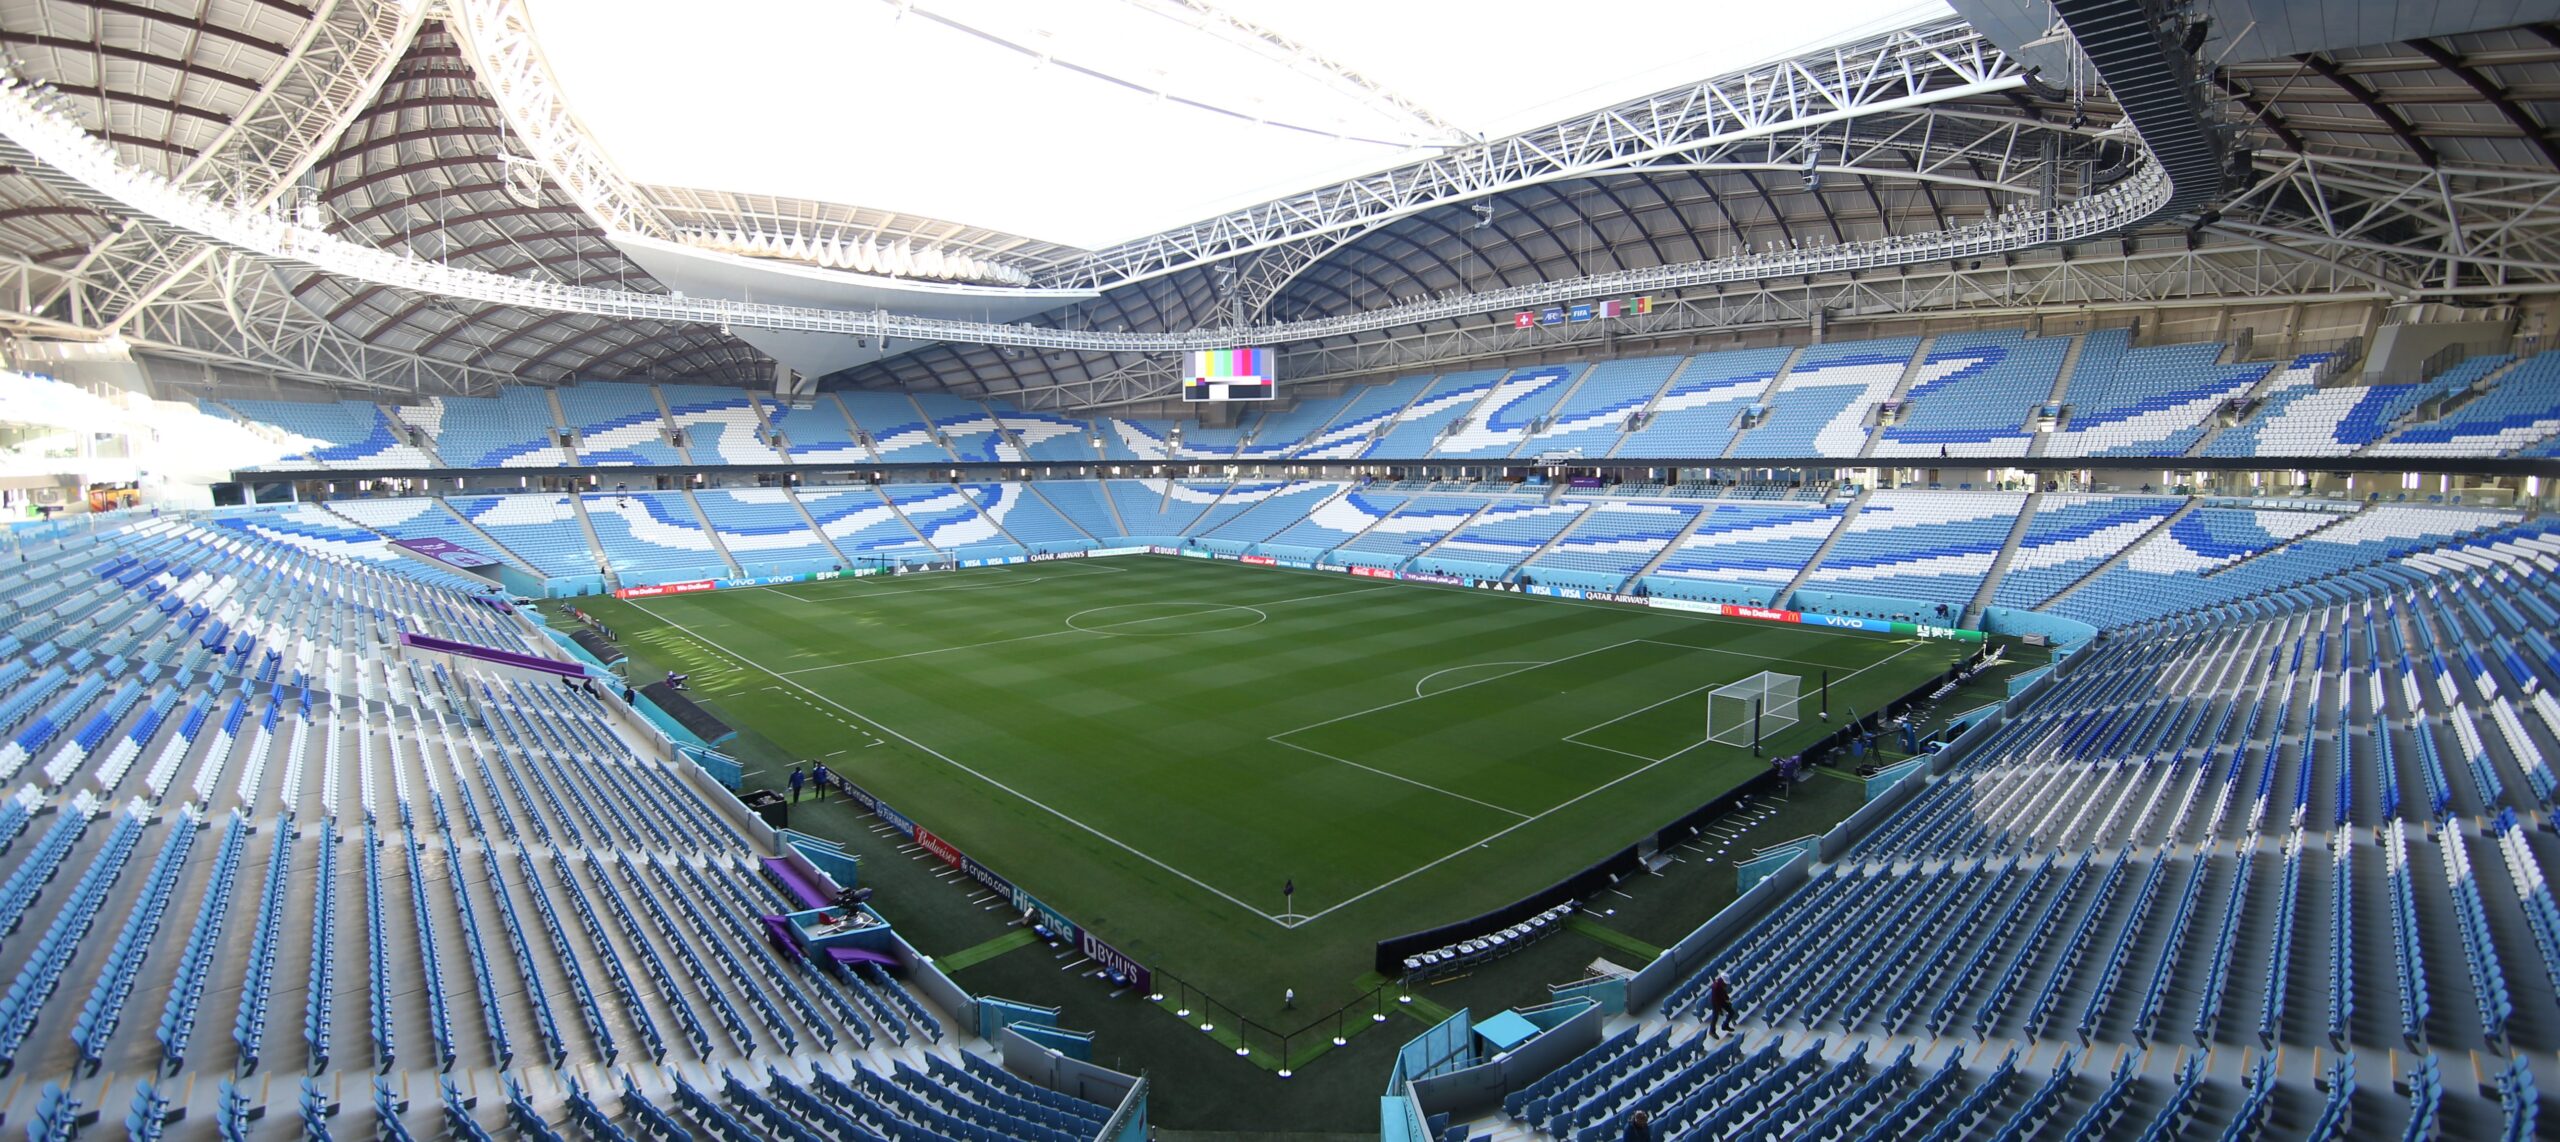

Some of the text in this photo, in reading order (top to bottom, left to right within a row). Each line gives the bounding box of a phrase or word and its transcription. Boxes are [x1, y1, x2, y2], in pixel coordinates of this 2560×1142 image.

[1544, 312, 1559, 321] AFC
[1573, 309, 1588, 317] FIFA
[987, 557, 1003, 565] VISA
[1010, 555, 1025, 563] VISA
[1030, 553, 1055, 562] QATAR
[1056, 550, 1085, 560] AIRWAYS
[728, 578, 756, 587] vivo
[767, 575, 794, 584] vivo
[688, 582, 711, 590] Deliver
[1532, 585, 1552, 596] VISA
[1560, 588, 1581, 599] VISA
[1586, 591, 1649, 605] QATAR AIRWAYS
[1738, 607, 1782, 618] We Deliver
[1825, 615, 1863, 628] vivo
[917, 827, 956, 864] Budweiser
[969, 864, 1011, 899] crypto.com
